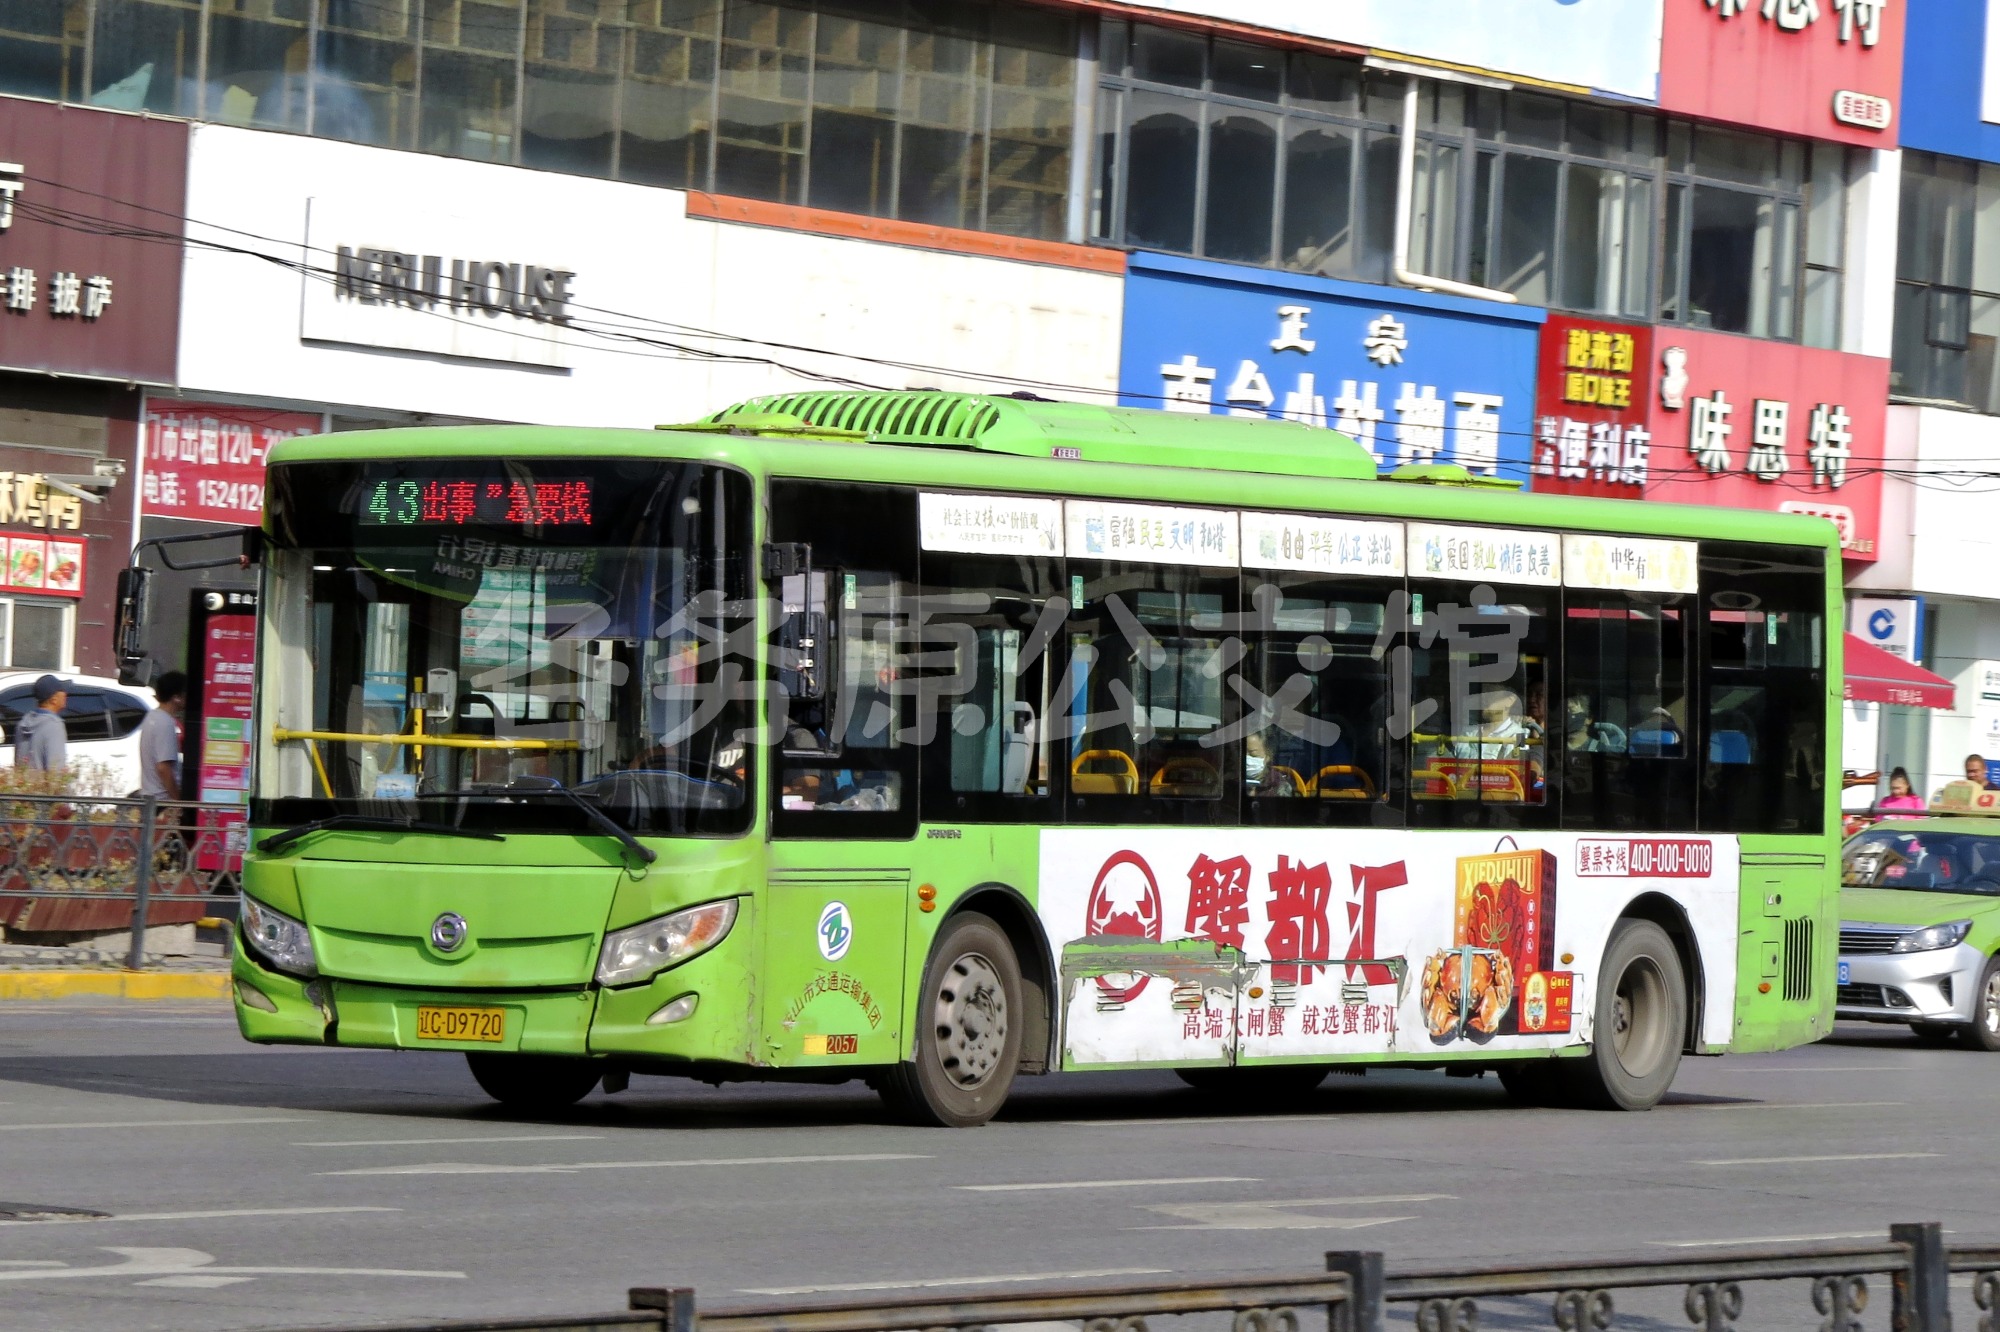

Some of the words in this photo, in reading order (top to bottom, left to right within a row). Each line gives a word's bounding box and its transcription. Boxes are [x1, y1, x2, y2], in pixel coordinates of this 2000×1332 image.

[52, 272, 112, 317] 披萨
[450, 258, 577, 327] HOUSE
[1270, 305, 1408, 366] 正宗
[1558, 418, 1651, 486] 便利店
[1690, 390, 1852, 489] 味思特
[368, 482, 420, 524] 43
[943, 504, 1039, 530] 社会主义核心价值观
[1579, 845, 1627, 872] 蟹票专线
[1630, 843, 1711, 872] 400-000-0018
[1182, 1006, 1286, 1040] 高端大闸蟹
[1300, 1004, 1400, 1036] 就选蟹都汇
[827, 1035, 858, 1054] 2057
